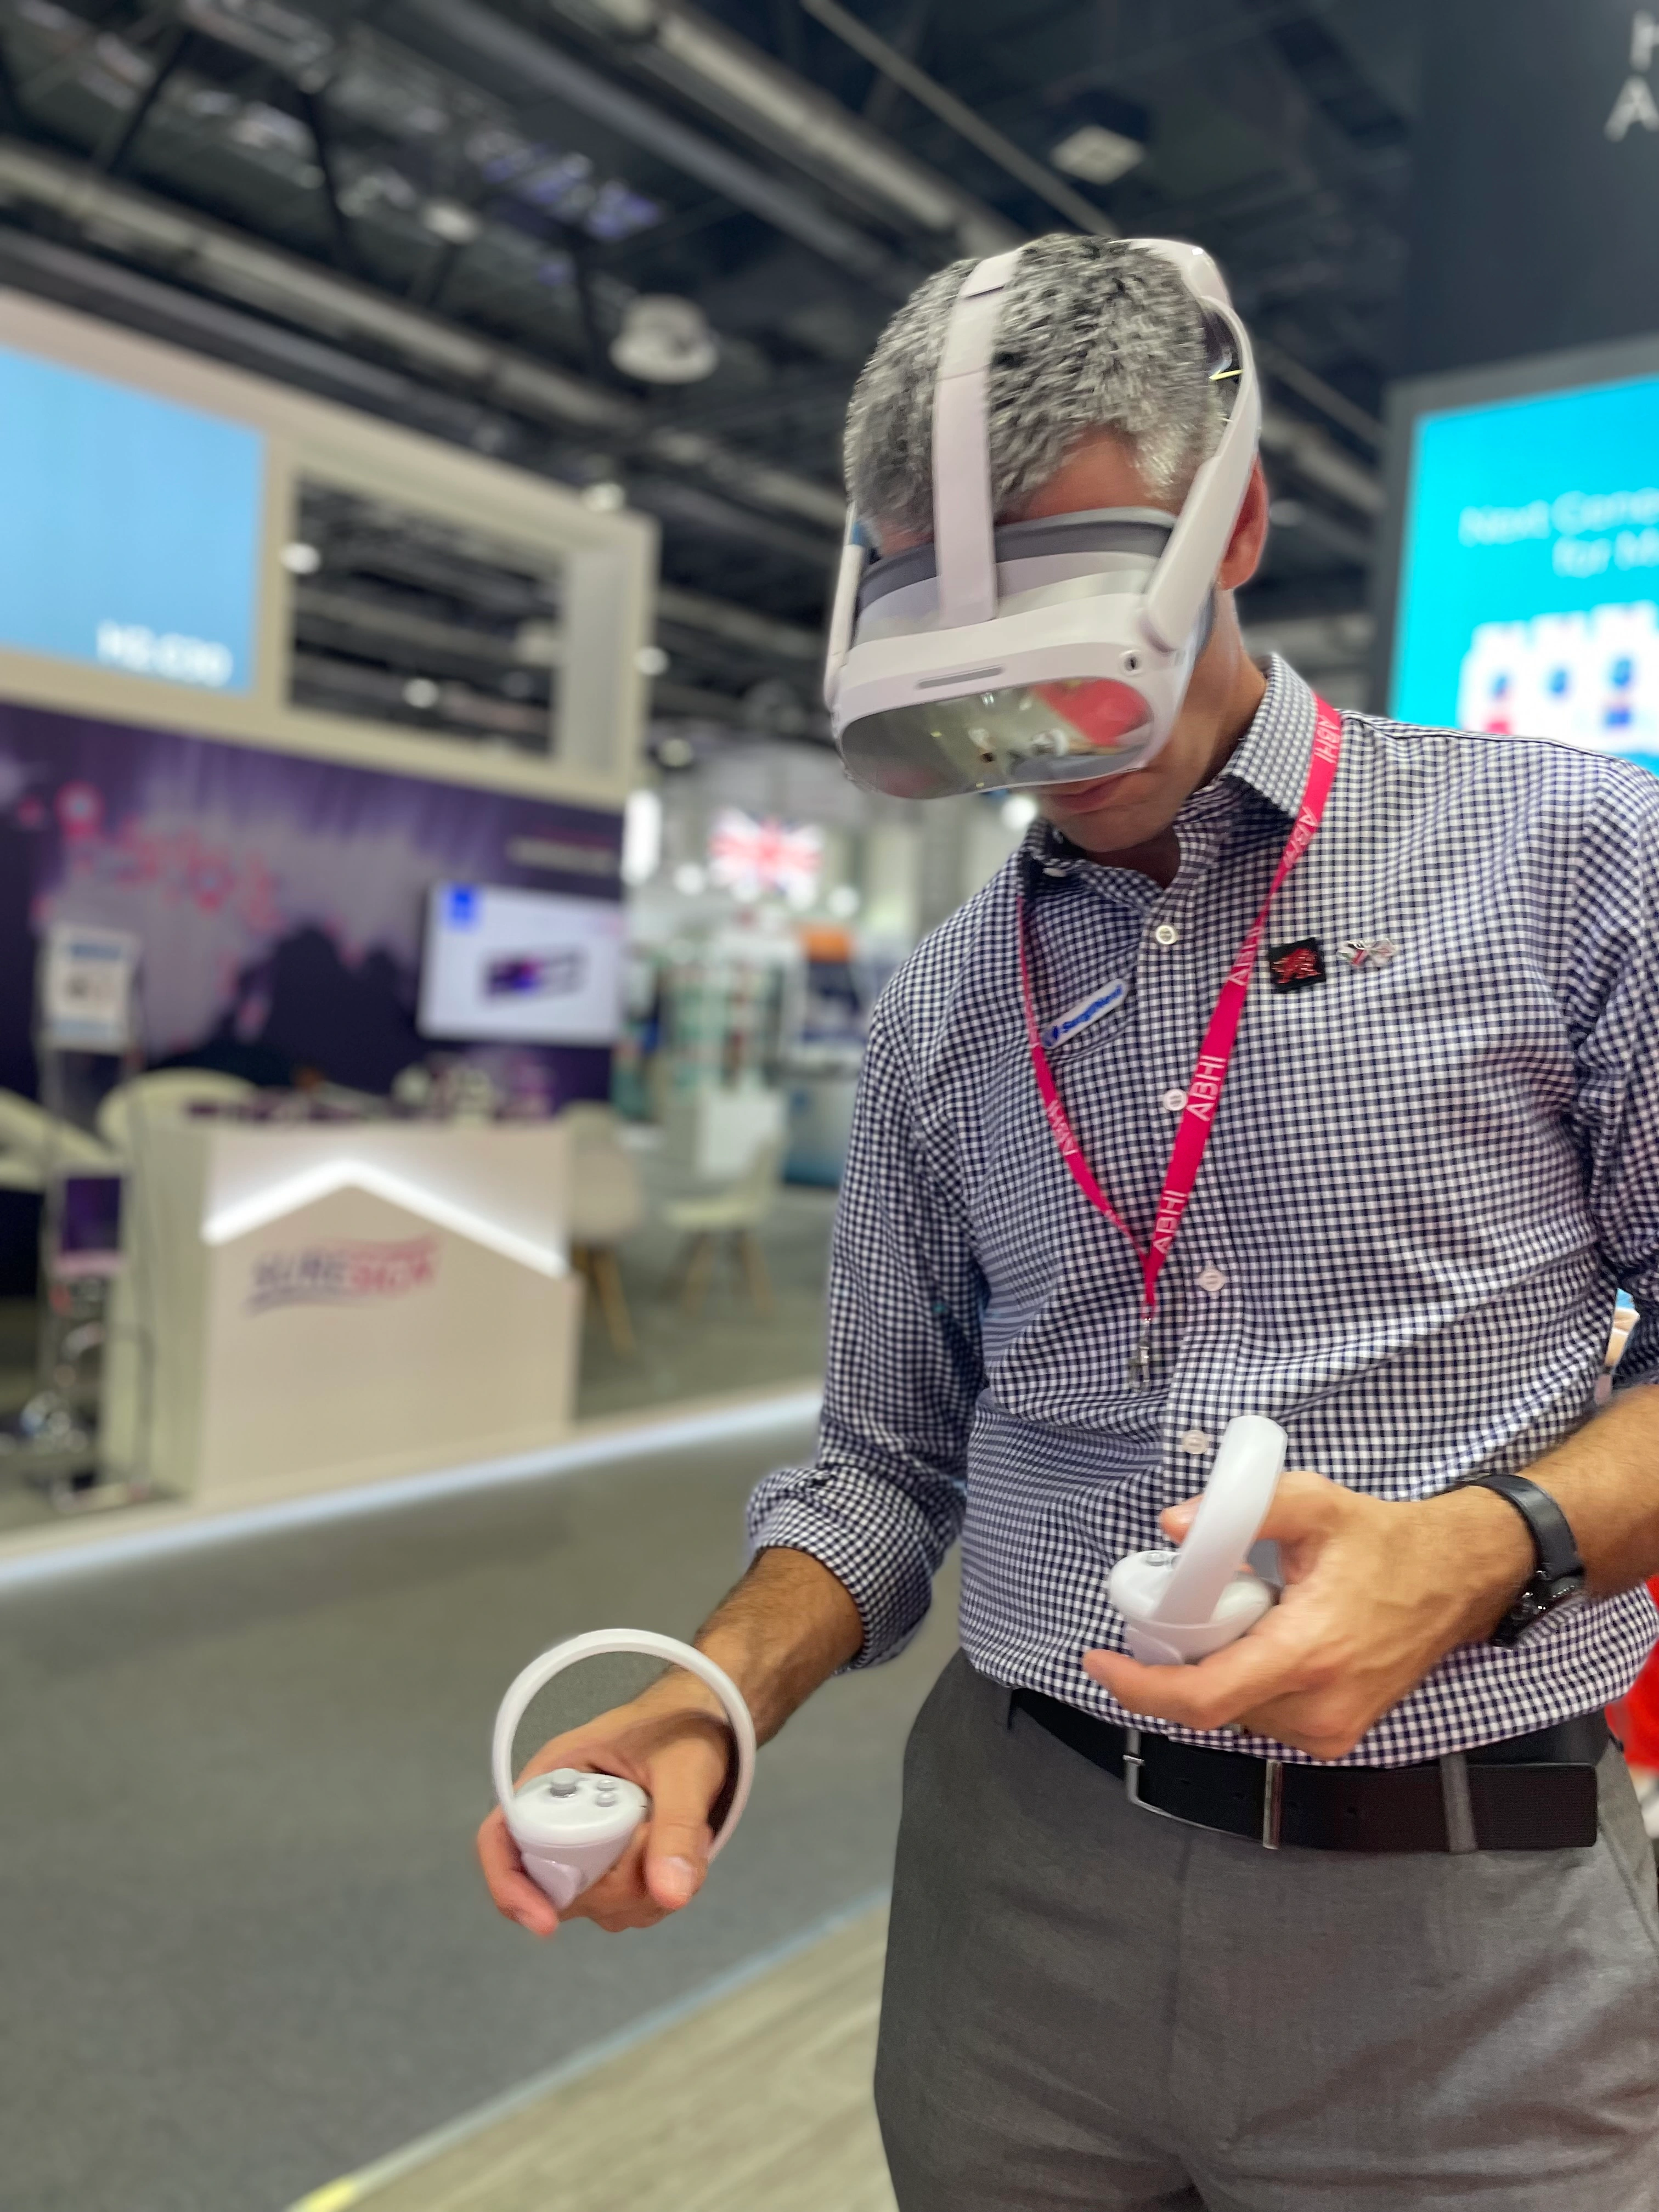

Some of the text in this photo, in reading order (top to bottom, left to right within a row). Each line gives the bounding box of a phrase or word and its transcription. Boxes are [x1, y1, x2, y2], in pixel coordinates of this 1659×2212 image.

[1314, 714, 1340, 764] ABHI
[1186, 1055, 1227, 1121] ABHI
[1153, 1189, 1188, 1255] ABHI
